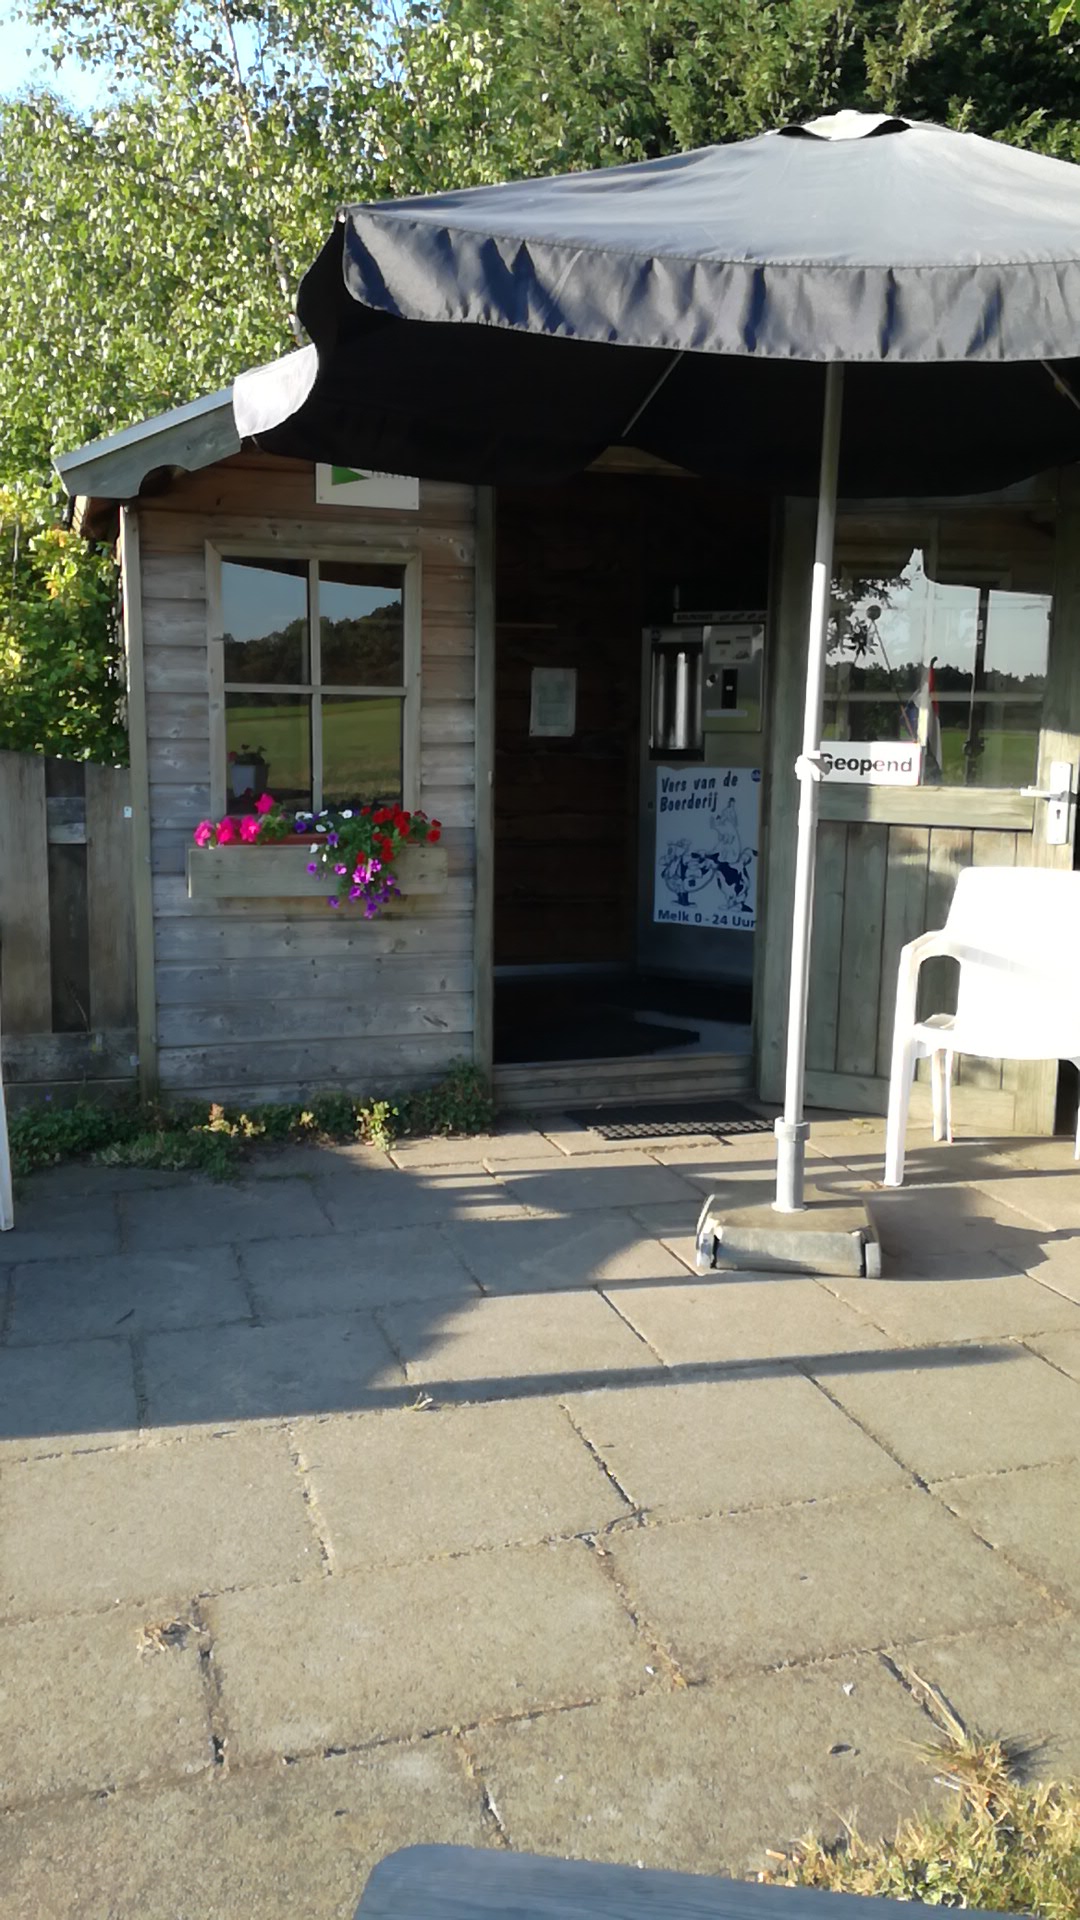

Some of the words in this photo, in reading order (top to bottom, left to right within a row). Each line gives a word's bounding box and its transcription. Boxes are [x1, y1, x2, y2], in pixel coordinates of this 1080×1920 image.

[820, 753, 913, 776] Geopend
[661, 777, 687, 793] Vers
[693, 777, 717, 789] van
[723, 771, 739, 788] de
[660, 792, 718, 812] Boerderij
[658, 909, 689, 923] Melk
[712, 914, 728, 925] 24
[732, 917, 756, 928] Uur
